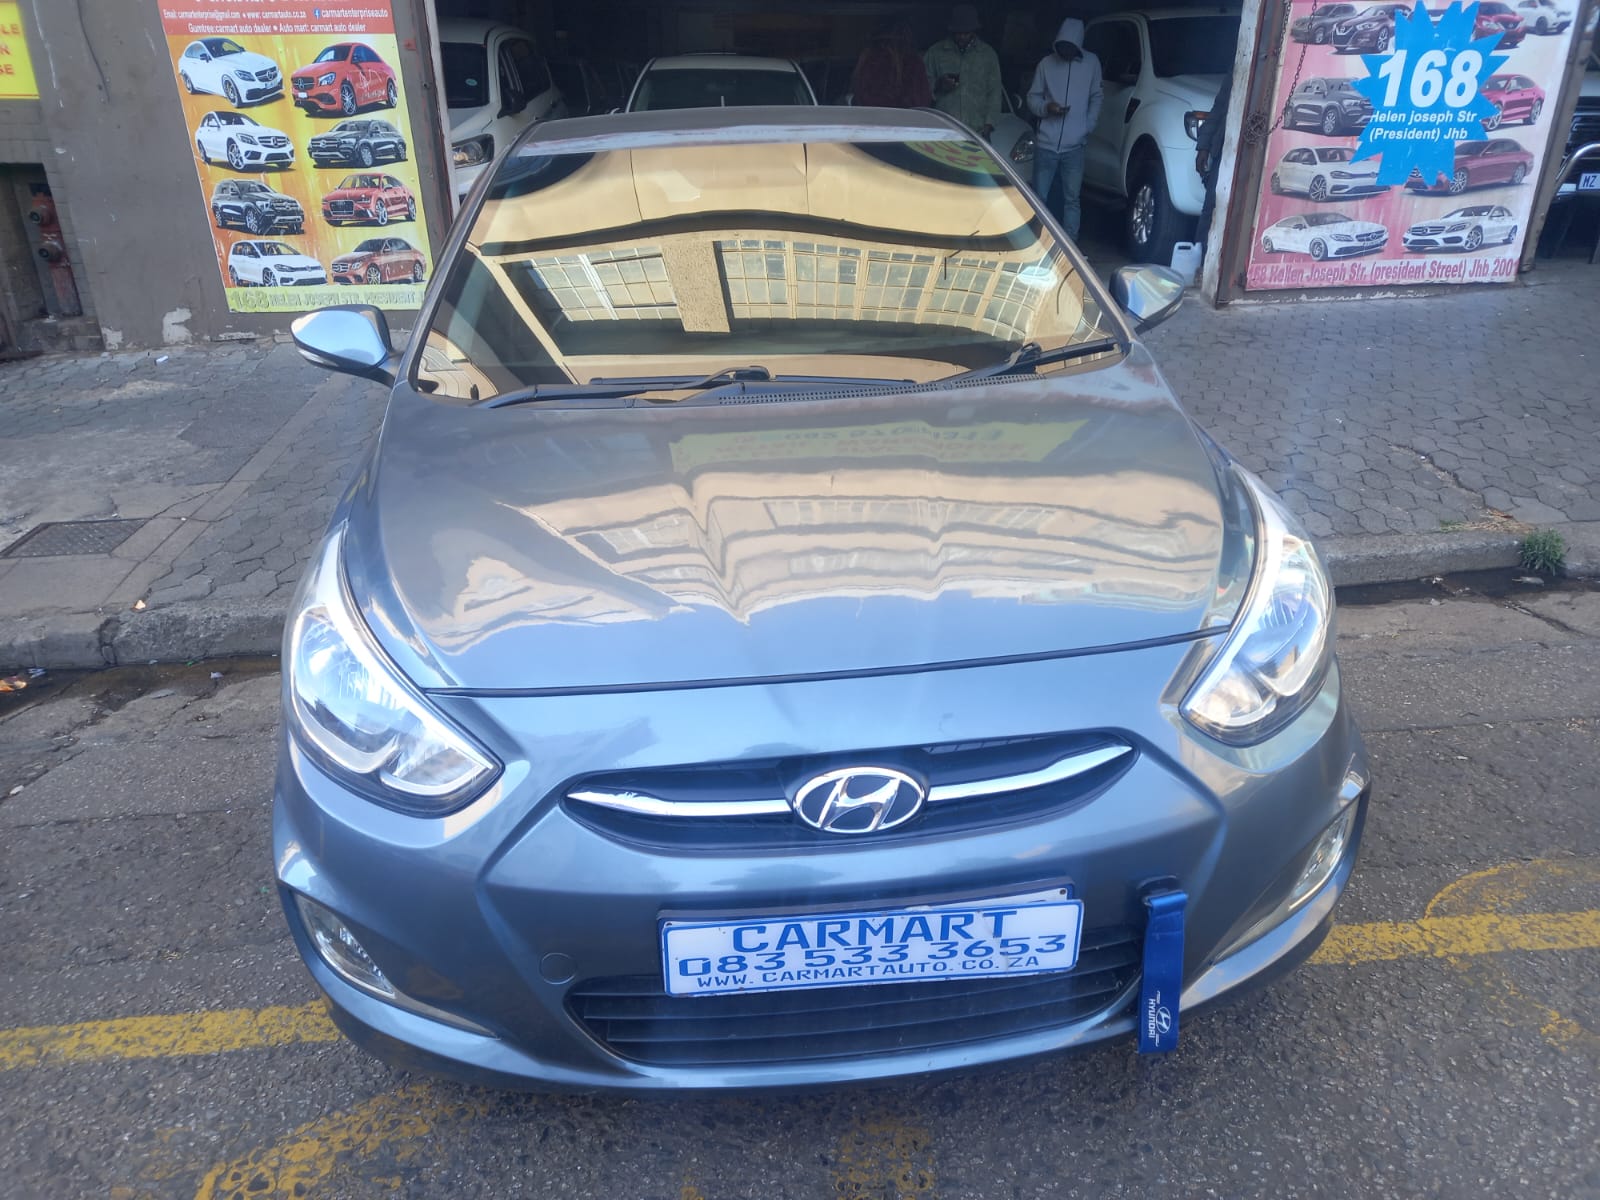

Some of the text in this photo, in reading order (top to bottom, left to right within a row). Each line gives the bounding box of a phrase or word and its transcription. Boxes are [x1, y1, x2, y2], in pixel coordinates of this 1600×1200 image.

[254, 23, 271, 32] dealer
[280, 23, 293, 32] Auto
[311, 24, 333, 32] carmart
[334, 23, 347, 31] auto
[348, 22, 366, 31] dealer
[1379, 49, 1483, 108] 168
[1370, 110, 1406, 123] Helen
[1408, 110, 1454, 125] joseph
[1370, 128, 1468, 142] (President) Jhb
[1308, 263, 1347, 284] Joseph
[1371, 260, 1427, 284] (president
[1429, 259, 1467, 281] Street)
[1469, 258, 1490, 278] Jhb
[733, 911, 1017, 953] CARMART
[678, 934, 1067, 977] 083 533 3653
[1148, 998, 1156, 1038] HYUNDAI
